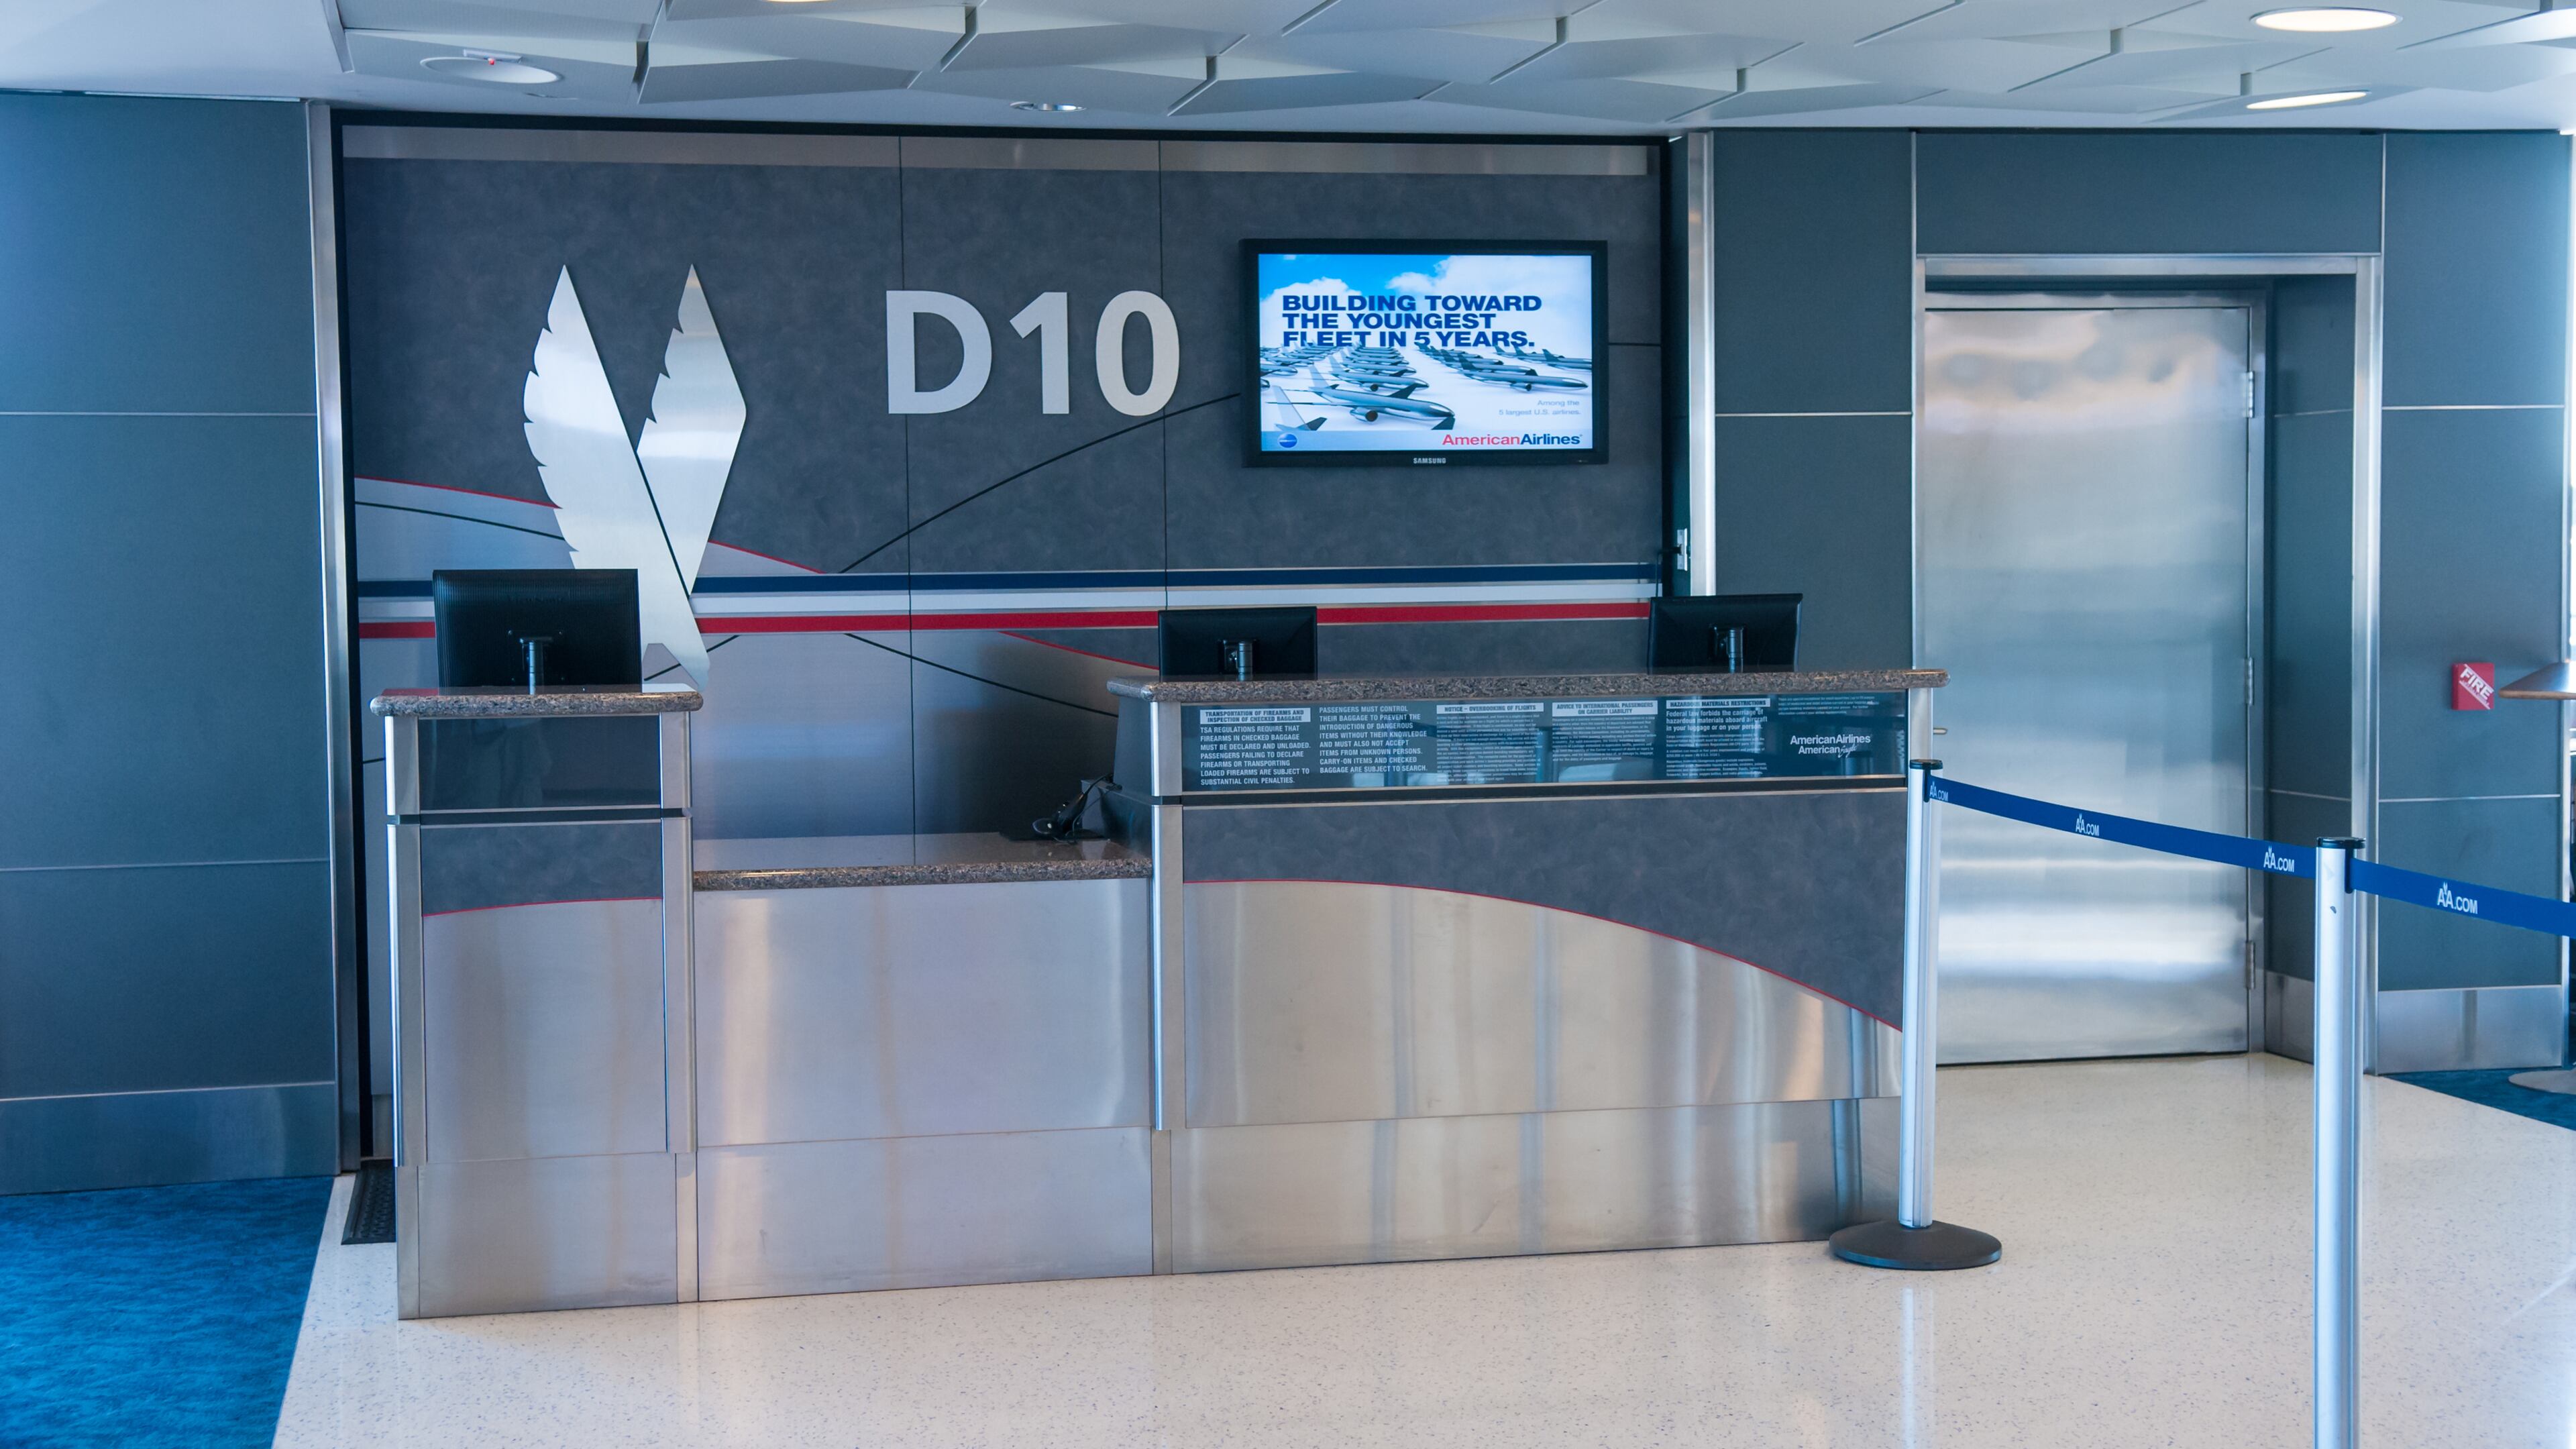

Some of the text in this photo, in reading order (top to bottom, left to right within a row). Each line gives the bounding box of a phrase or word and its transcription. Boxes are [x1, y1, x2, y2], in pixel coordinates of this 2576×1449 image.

[1283, 295, 1542, 311] BUILDING TOWARD
[1283, 313, 1497, 329] THE YOUNGEST
[1283, 331, 1535, 347] FLEET IN 5 YEARS.
[886, 290, 1179, 416] D10
[2461, 669, 2494, 700] FIRE
[2076, 818, 2099, 836] AA.COM
[2263, 852, 2294, 872] AA.COM
[2437, 888, 2478, 914] AA.COM
